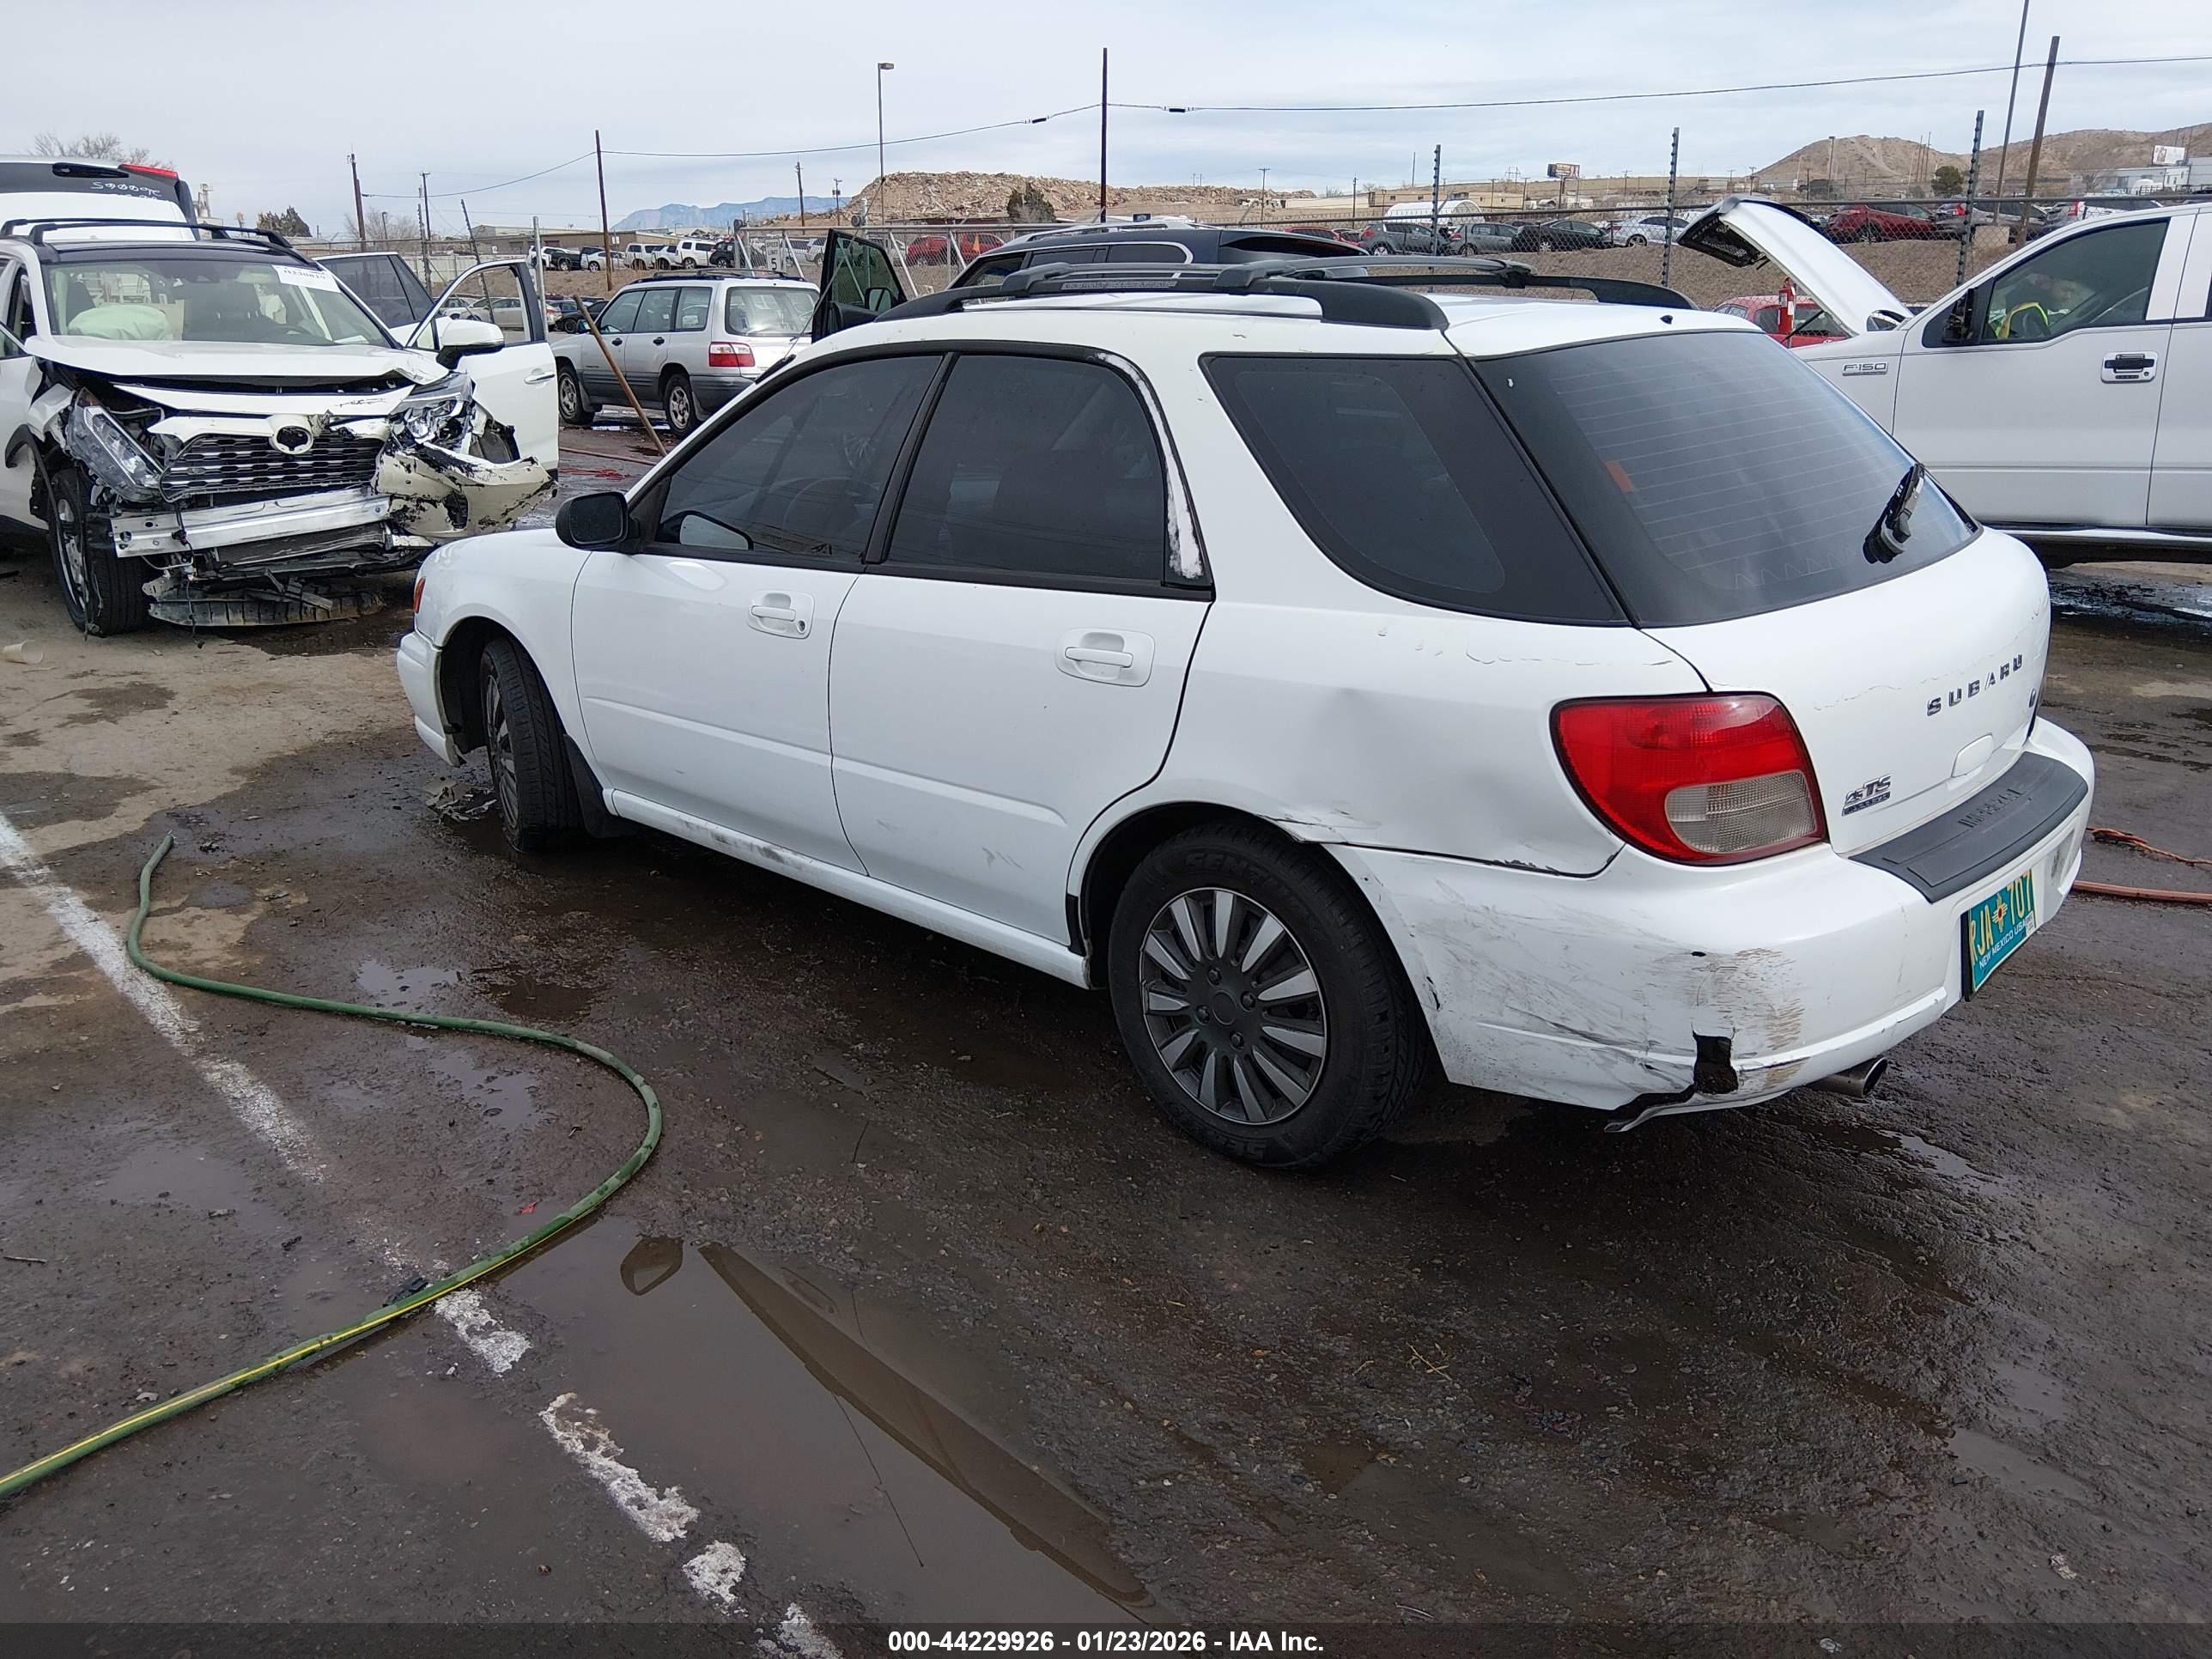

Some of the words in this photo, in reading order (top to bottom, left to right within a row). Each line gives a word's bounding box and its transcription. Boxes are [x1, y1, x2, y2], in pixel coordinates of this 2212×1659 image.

[771, 258, 777, 270] 5
[1927, 653, 2023, 716] SUBARU
[1969, 904, 1994, 965] RJA
[2007, 870, 2032, 926] 707
[1979, 950, 1992, 969] NEW
[1992, 928, 2014, 957] MEXICO
